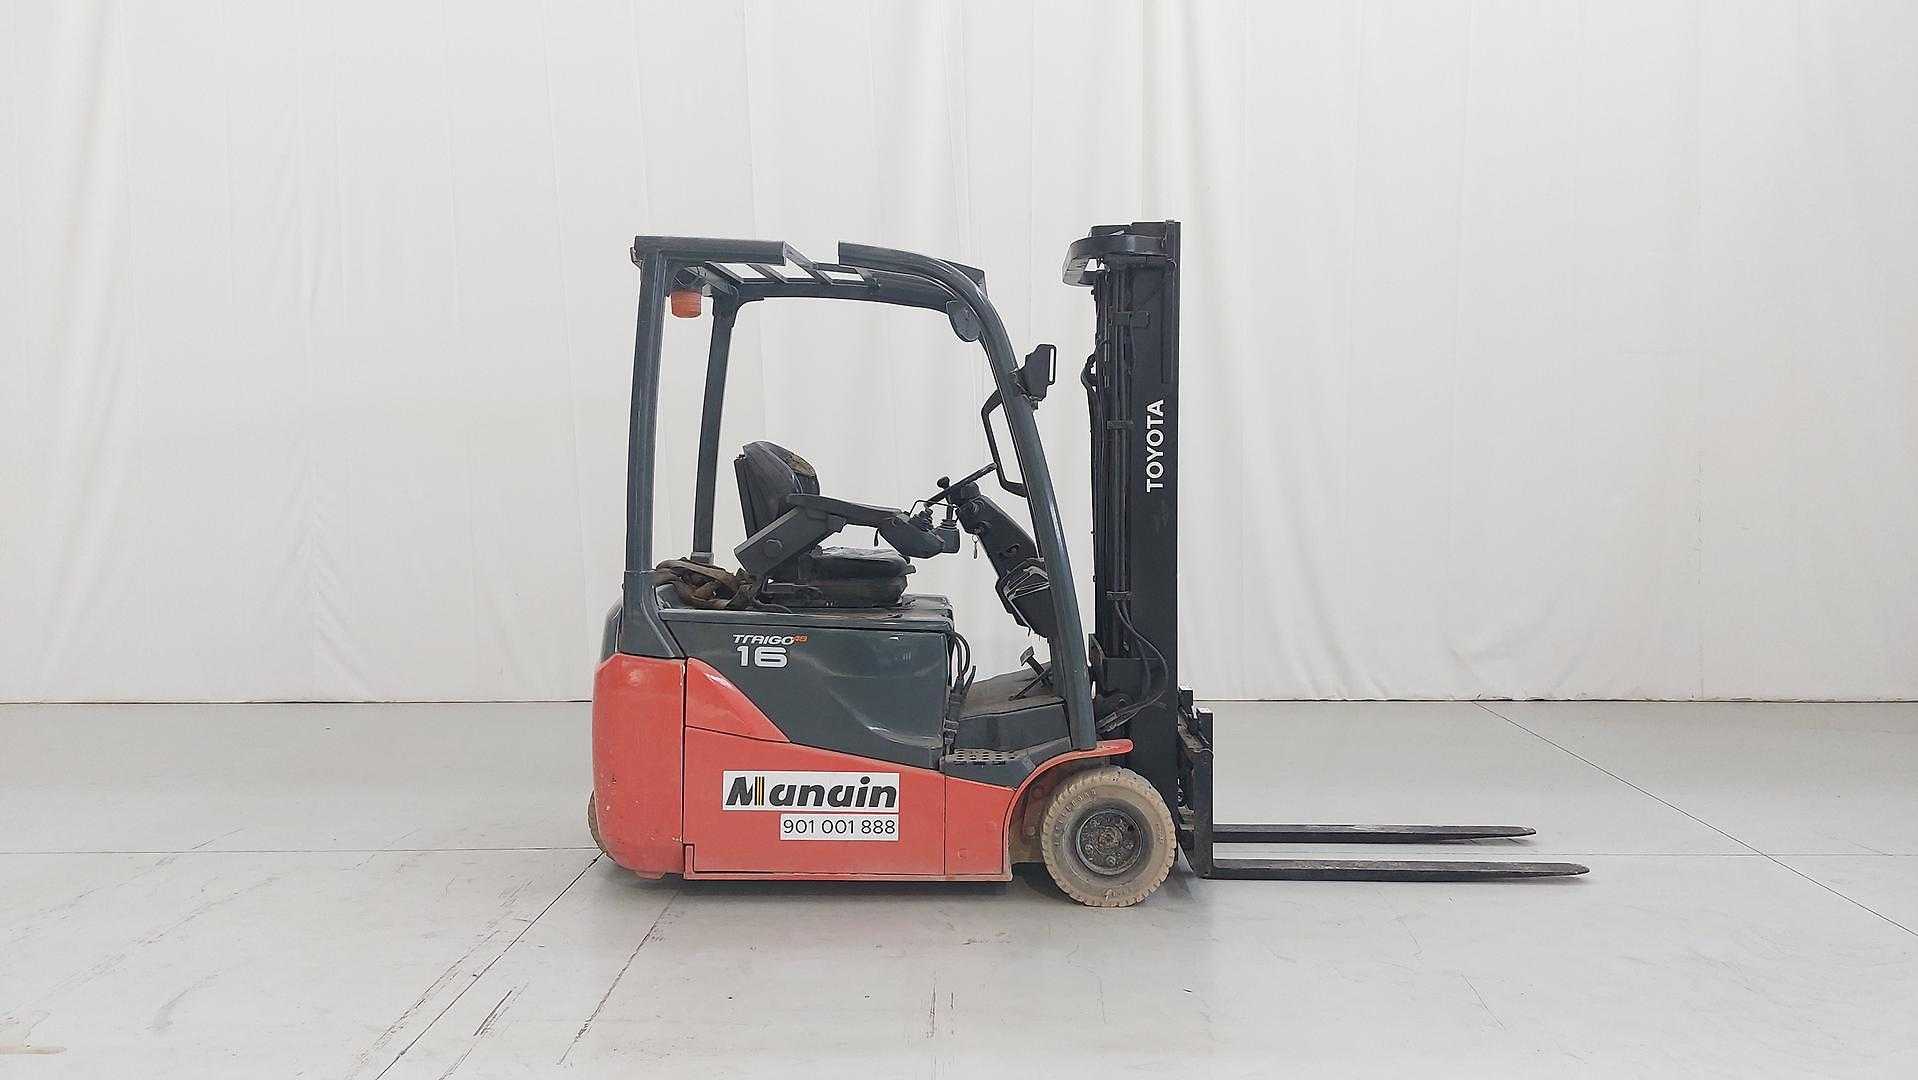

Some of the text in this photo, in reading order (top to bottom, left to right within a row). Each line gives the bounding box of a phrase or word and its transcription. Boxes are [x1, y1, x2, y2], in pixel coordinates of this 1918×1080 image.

[1146, 400, 1164, 493] TOYOTA
[737, 645, 788, 668] 16
[725, 776, 897, 808] Manain
[783, 819, 896, 834] 901 001 888
